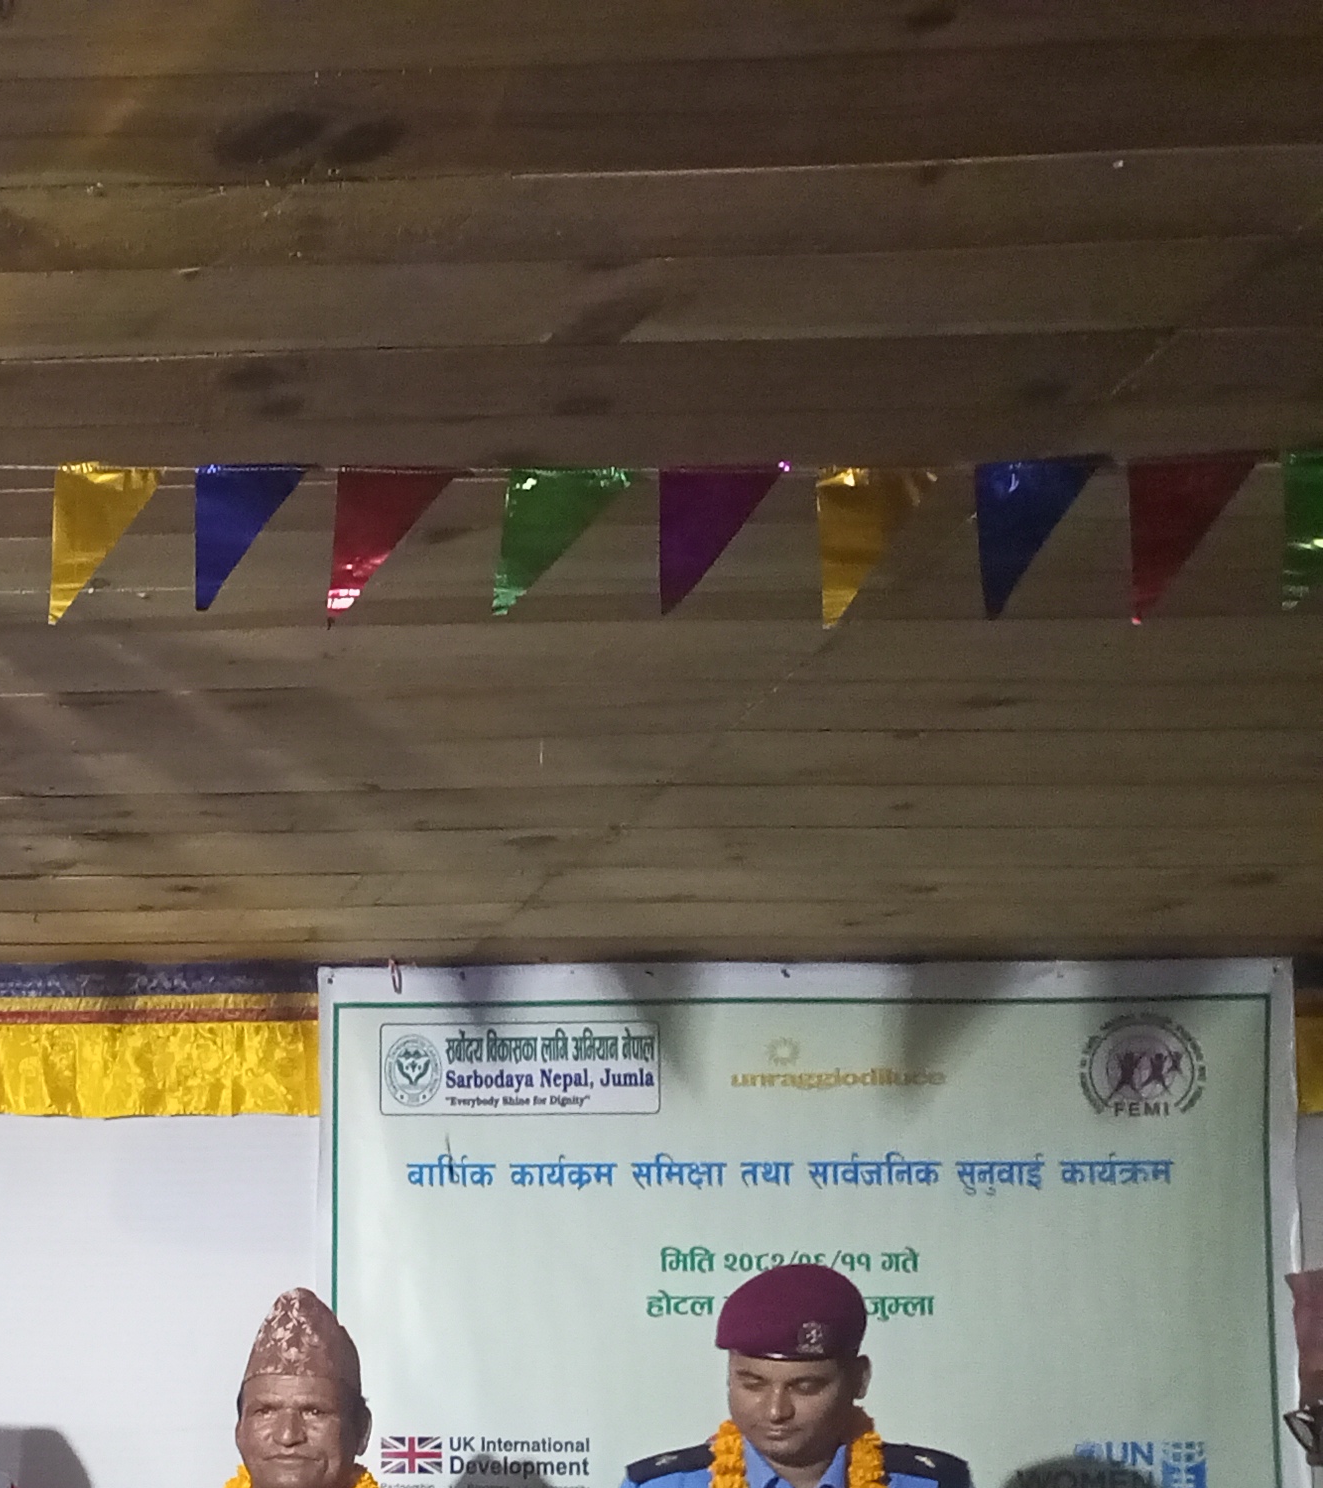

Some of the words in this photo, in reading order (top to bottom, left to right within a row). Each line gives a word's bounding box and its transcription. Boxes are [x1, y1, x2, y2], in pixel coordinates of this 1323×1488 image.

[445, 1069, 534, 1092] Sarbodaya
[540, 1069, 594, 1092] Nepal,
[600, 1068, 655, 1087] Jumla
[533, 1095, 547, 1106] for
[1114, 1101, 1170, 1117] FEMI
[509, 1155, 618, 1190] कार्यक्रम
[631, 1153, 727, 1190] समिक्षा
[741, 1161, 794, 1188] तथा
[808, 1152, 943, 1189] सार्वजनिक
[955, 1153, 1045, 1196] सुनुवाई
[1060, 1152, 1174, 1188] कार्यक्रम
[660, 1246, 715, 1273] मिति
[881, 1247, 920, 1273] गते
[646, 1290, 715, 1317] होटल
[865, 1295, 935, 1321] जुम्ला
[449, 1436, 476, 1452] UK
[481, 1436, 590, 1453] International
[1106, 1441, 1154, 1466] UN
[450, 1456, 590, 1479] Development
